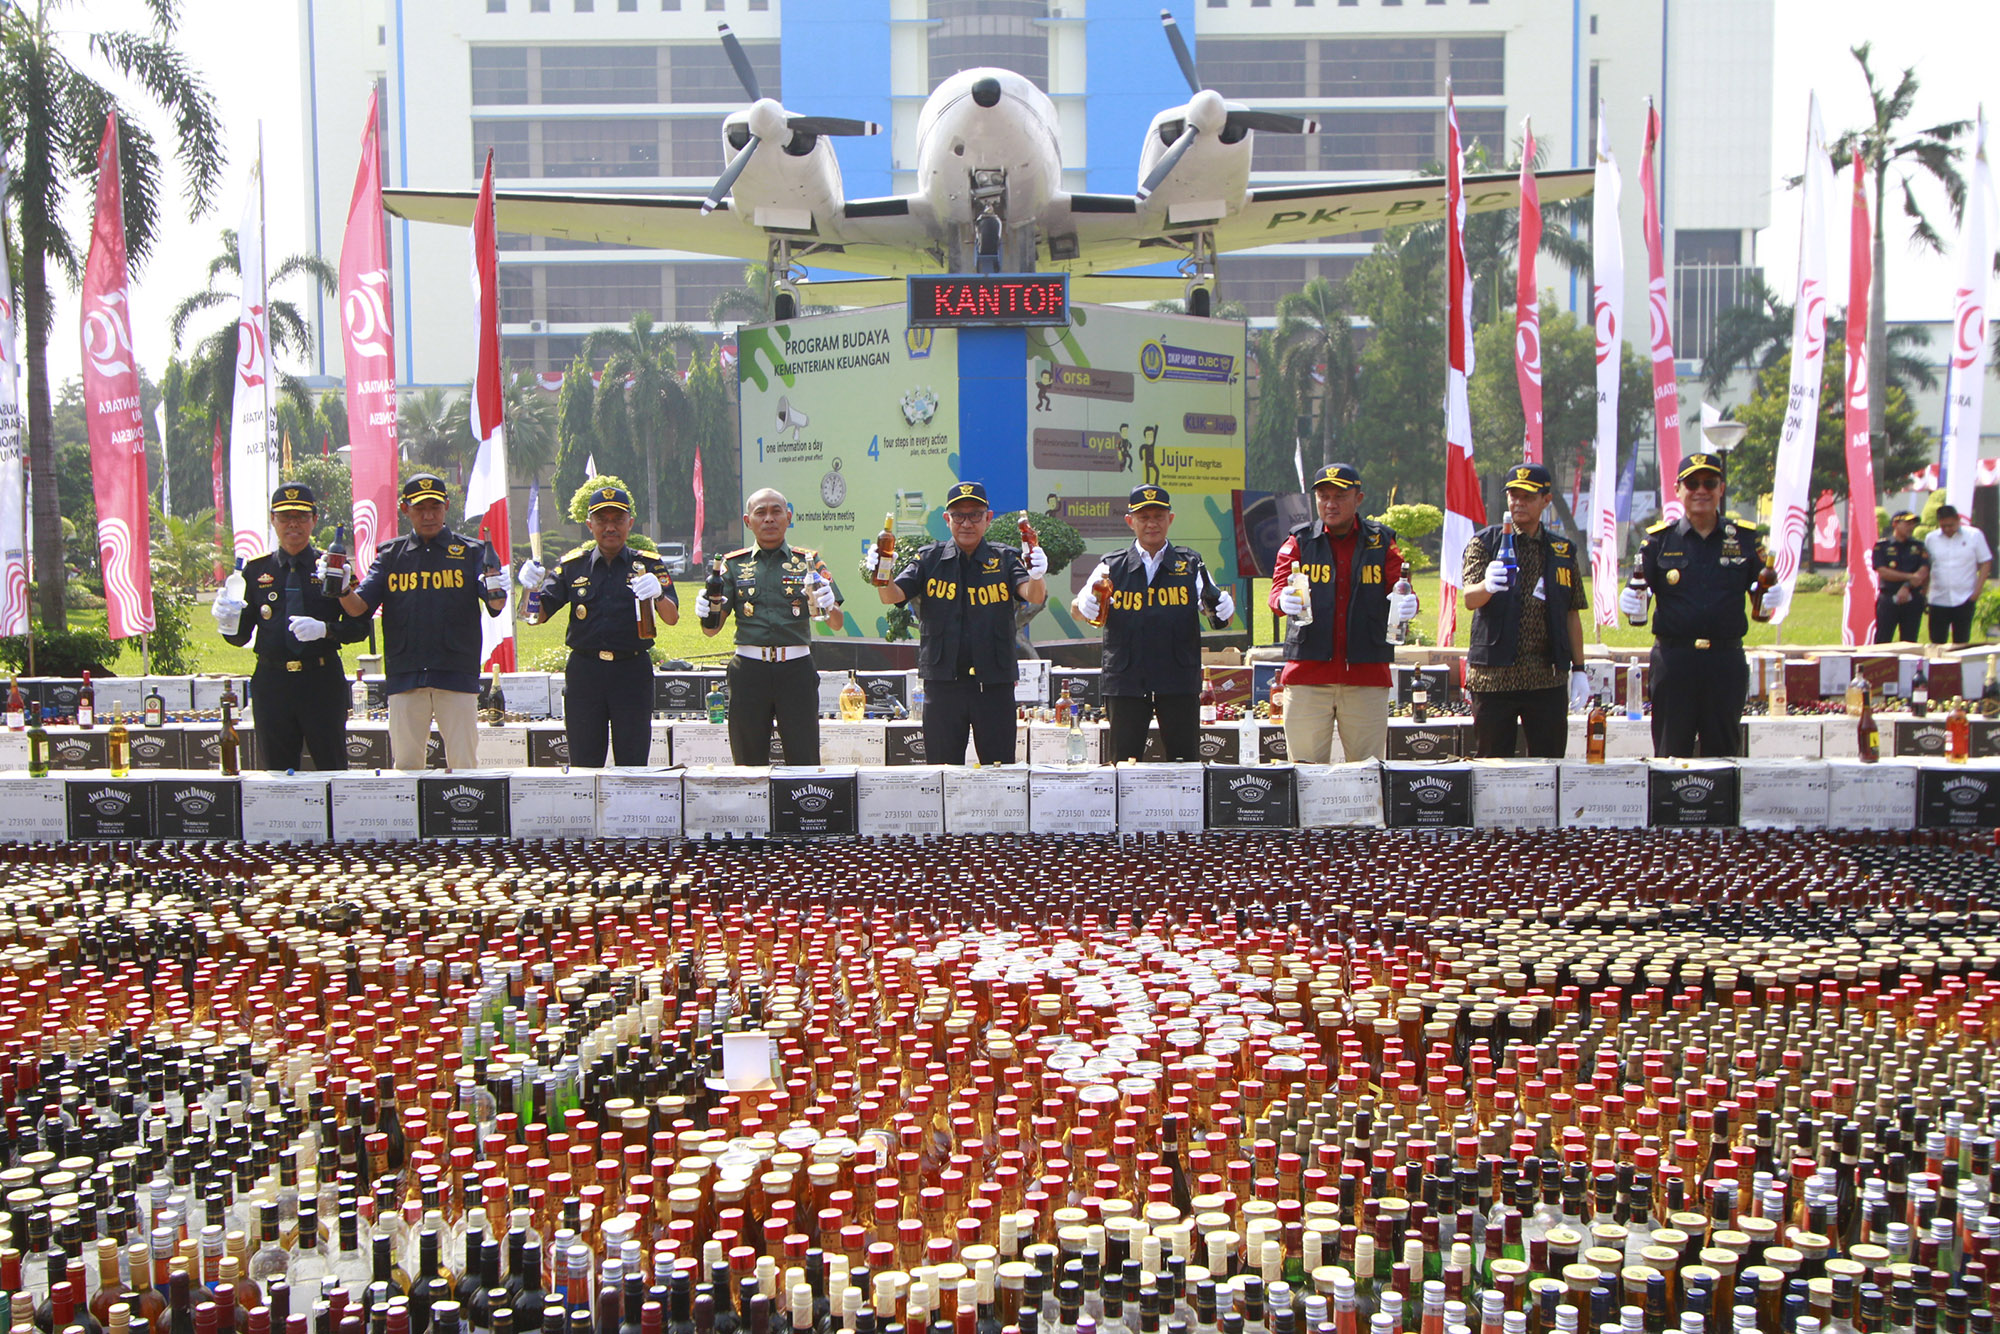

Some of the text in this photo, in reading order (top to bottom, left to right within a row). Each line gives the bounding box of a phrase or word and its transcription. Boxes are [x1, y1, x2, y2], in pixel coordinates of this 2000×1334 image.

[785, 328, 890, 355] PROGRAM BUDAYA
[774, 352, 890, 376] KEMENTERIAN KEUANGAN
[1198, 356, 1219, 367] DJBC
[1055, 367, 1091, 385] Korsa
[766, 444, 776, 454] one
[777, 441, 807, 453] information
[812, 440, 823, 452] day
[867, 435, 879, 462] 4
[883, 433, 948, 449] four steps in every action
[1081, 432, 1115, 452] Loyal
[757, 437, 763, 463] 1
[1161, 449, 1222, 472] Jujur Integritas
[796, 511, 855, 523] two minutes before meeting
[1063, 501, 1110, 517] Inisiatif
[388, 569, 464, 592] CUSTOMS
[1229, 774, 1273, 791] JACK DANIEL'S
[1409, 775, 1453, 792] JACK DANIEL'S
[88, 787, 132, 804] JACK DANIEL'S
[174, 786, 217, 803] JACK DANIEL'S
[442, 785, 486, 801] JACK DANIEL'S
[791, 784, 835, 801] JACK DANIEL'S
[1322, 796, 1350, 805] 2731501
[884, 810, 912, 818] 2731501
[917, 810, 938, 818] 02670
[971, 809, 999, 817] 2731501
[1004, 809, 1024, 817] 02759
[1056, 809, 1111, 817] 2731501 02224
[1145, 808, 1173, 816] 2731501
[1178, 808, 1199, 816] 02257
[1499, 806, 1527, 814] 2731501
[8, 818, 36, 826] 2731501
[269, 819, 297, 828] 2731501
[360, 818, 388, 827] 2731501
[537, 815, 592, 824] 2731501 01976
[622, 814, 676, 824] 2731501 02241
[711, 815, 766, 824] 2731501 02416
